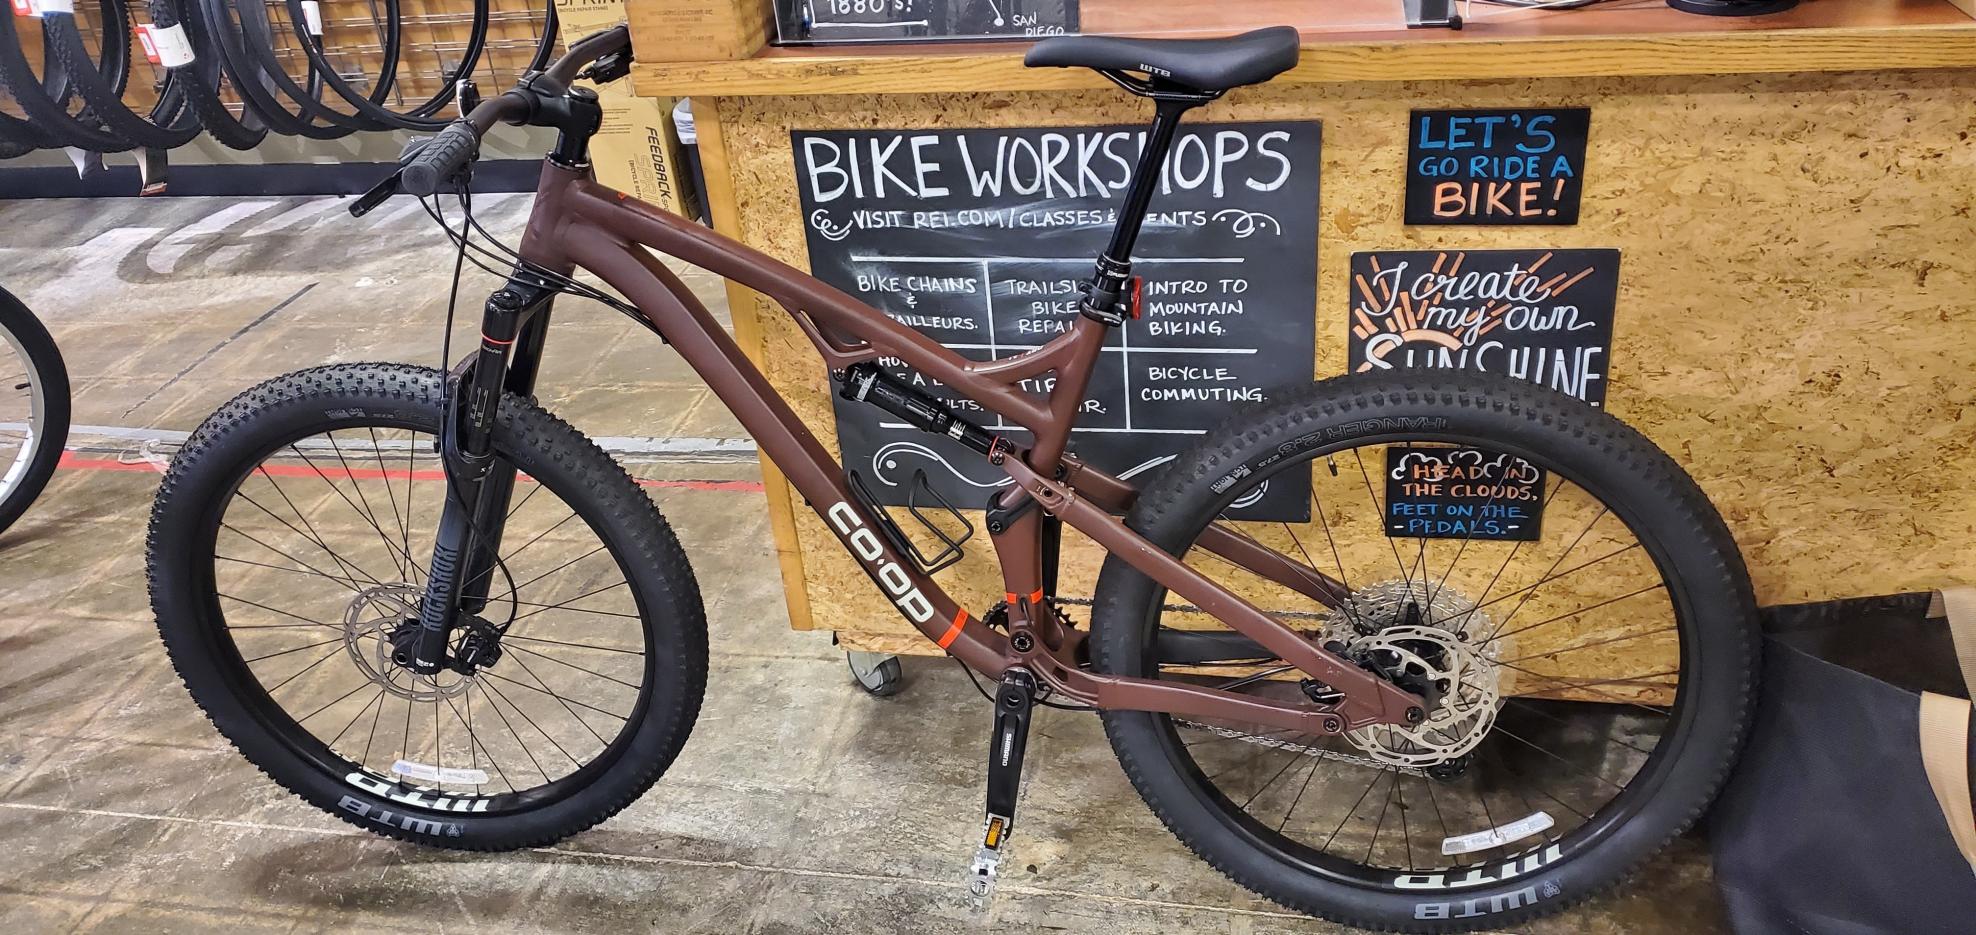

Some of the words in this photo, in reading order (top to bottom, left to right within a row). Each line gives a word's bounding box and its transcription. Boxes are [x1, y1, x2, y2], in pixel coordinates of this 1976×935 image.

[1012, 11, 1037, 27] SAN
[1025, 25, 1065, 37] DIEGO
[1140, 63, 1171, 78] WTB
[1418, 114, 1557, 154] LET'S
[645, 126, 672, 200] FEEDBACK
[803, 135, 949, 202] BIKE
[1418, 156, 1459, 177] GO
[1470, 155, 1541, 180] RIDE
[1550, 155, 1574, 178] A
[1433, 178, 1566, 217] BIKE!
[853, 210, 904, 229] VISIT
[858, 275, 900, 292] BIKE
[907, 276, 977, 294] CHAINS
[1004, 279, 1077, 295] TRAILSI
[1148, 280, 1208, 295] INTRO
[1219, 279, 1248, 294] TO
[1361, 261, 1408, 316] I
[1410, 262, 1552, 304] create
[1032, 301, 1080, 315] BIKE
[1149, 300, 1243, 317] MOUNTAIN
[1018, 319, 1074, 334] REPAI
[1148, 321, 1227, 336] BIKING.
[1422, 304, 1491, 347] my
[1505, 304, 1597, 331] own
[1148, 366, 1237, 381] BICYCLE
[1141, 387, 1268, 402] COMMUTING.
[1327, 416, 1443, 439] RANGER
[1279, 431, 1323, 456] 2.8
[1413, 464, 1484, 480] HEAD
[1504, 466, 1527, 480] IN
[1402, 483, 1443, 497] THE
[1450, 484, 1538, 501] CLOUDS,
[1392, 502, 1440, 516] FEET
[1446, 504, 1474, 517] ON
[1480, 505, 1529, 519] THE
[1409, 518, 1507, 535] PEDALS.
[421, 542, 459, 632] ROCKSHOX
[1001, 733, 1012, 767] SHIMANO
[337, 795, 443, 836] WTB
[1414, 886, 1538, 920] WTB
